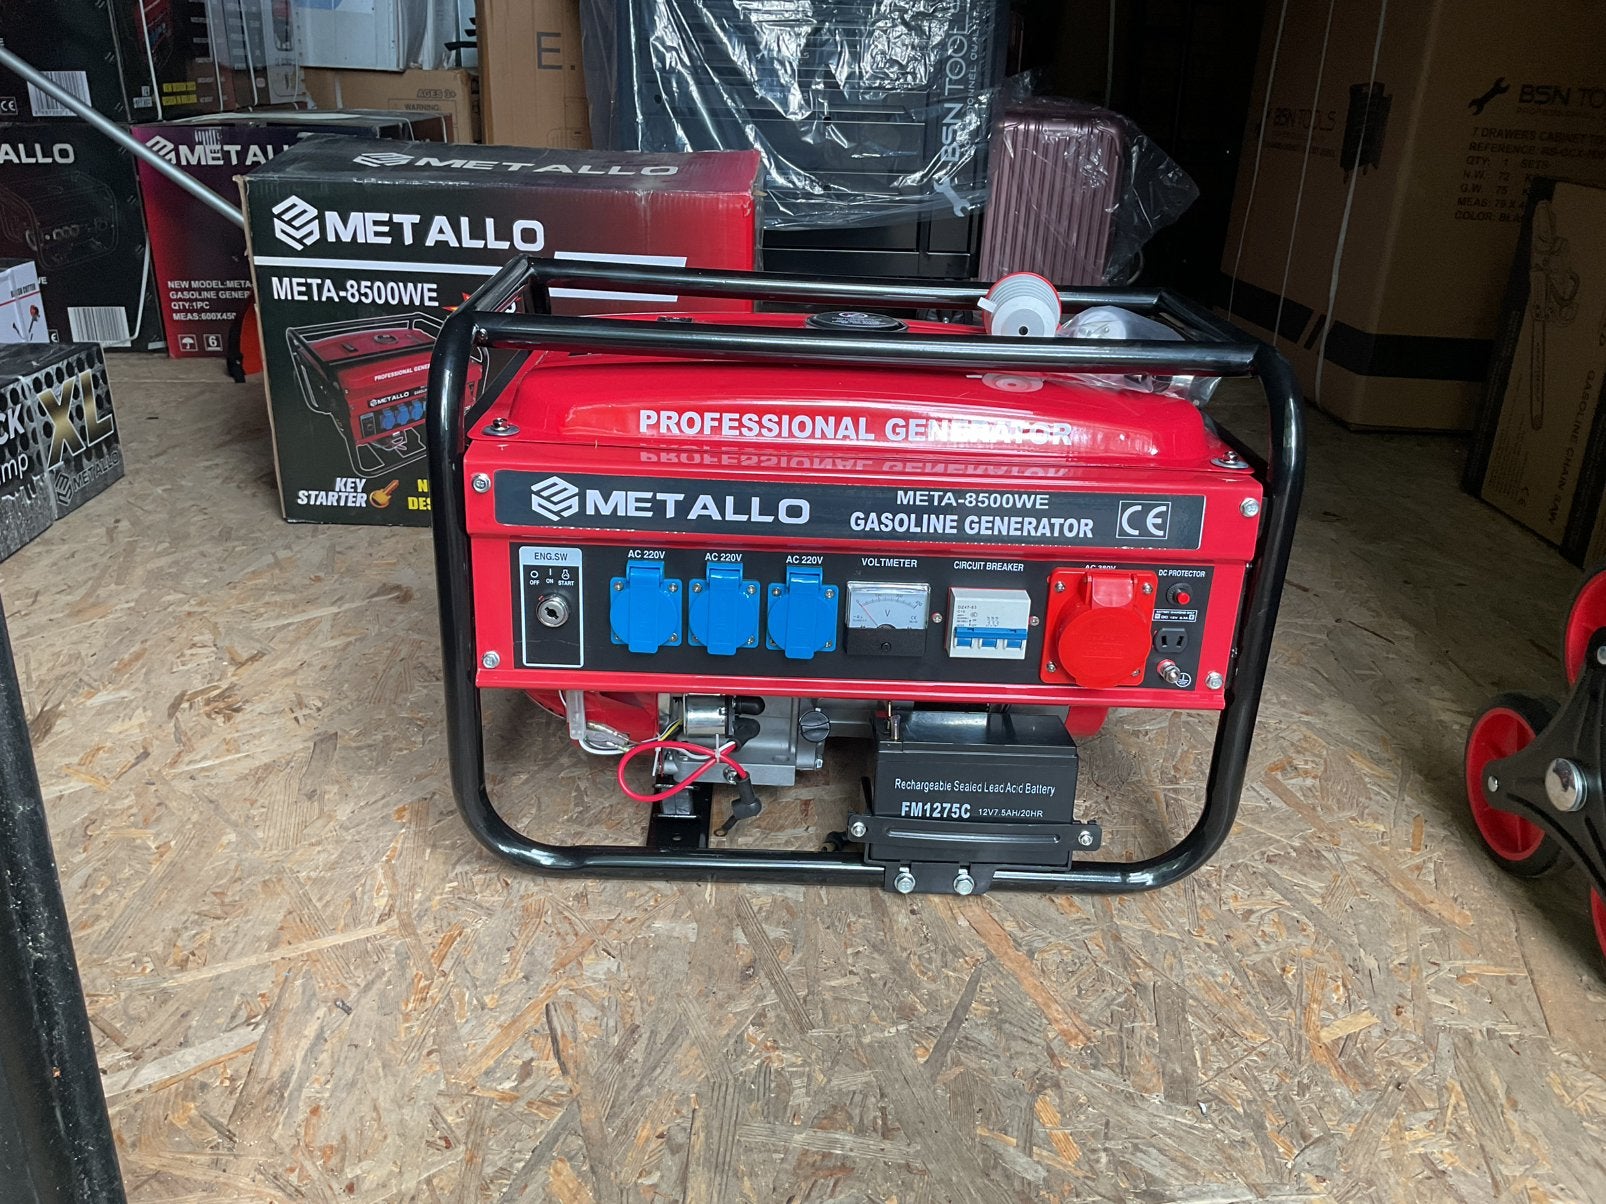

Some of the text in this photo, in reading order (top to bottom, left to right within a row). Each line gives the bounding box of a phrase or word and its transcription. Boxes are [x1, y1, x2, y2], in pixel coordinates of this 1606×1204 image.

[1519, 84, 1571, 106] BSN
[413, 156, 679, 176] METALLO
[324, 211, 545, 252] METALLO
[167, 280, 190, 289] NEW
[271, 277, 439, 307] META-8500WE
[169, 291, 217, 299] GASOLINE
[171, 302, 210, 310] QTY:1PC
[377, 391, 410, 405] METALLO
[37, 369, 114, 470] XL
[639, 409, 1073, 447] PROFESSIONAL GENERATOR
[71, 450, 120, 490] METALLO
[335, 477, 367, 492] KEY
[297, 490, 368, 507] STARTER
[585, 489, 811, 525] METALLO
[896, 490, 1050, 510] META-8500WE
[850, 511, 1094, 538] GASOLINE GENERATOR
[1121, 504, 1169, 537] CE
[534, 552, 568, 561] ENG.SW
[628, 549, 666, 560] AC 220V
[704, 552, 743, 563] AC 220V
[786, 555, 824, 565] AC 220V
[861, 557, 918, 569] VOLTMETER
[953, 560, 1025, 573] CIRCUIT BREAKER
[1158, 569, 1206, 578] DC PROTECTOR
[894, 778, 951, 793] Rechargeable
[953, 781, 982, 792] Sealed
[984, 782, 1004, 793] Lead
[1025, 783, 1056, 797] Battery
[901, 801, 971, 819] FM1275C
